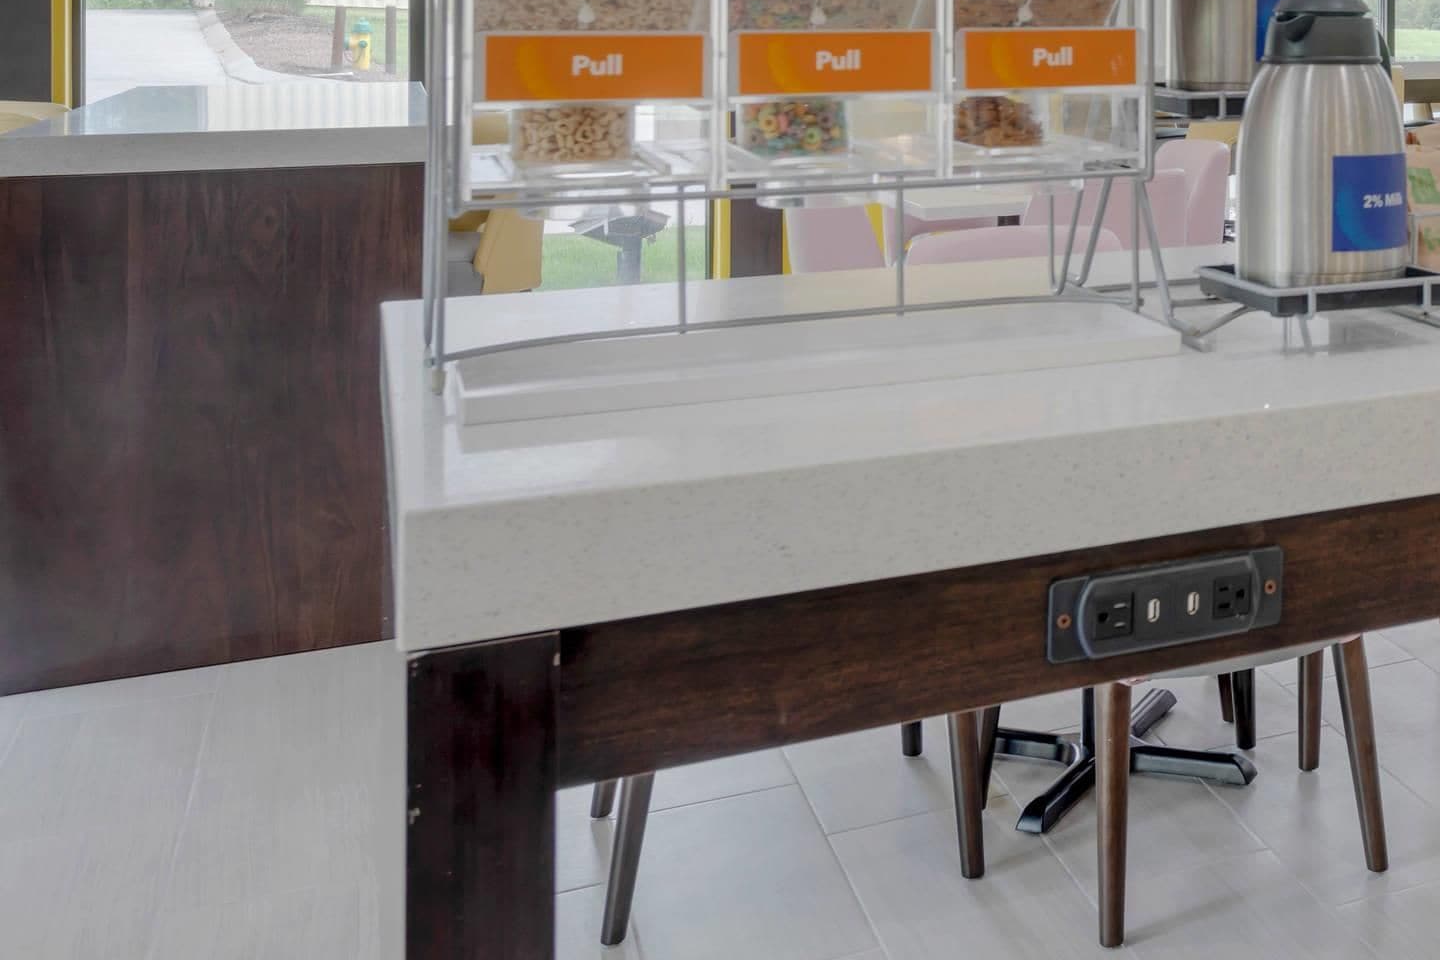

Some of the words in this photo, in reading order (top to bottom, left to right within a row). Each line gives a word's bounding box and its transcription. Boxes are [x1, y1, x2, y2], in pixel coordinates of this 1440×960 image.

[572, 53, 623, 77] Pull
[815, 49, 861, 71] Pull
[1032, 46, 1073, 67] Pull
[1363, 194, 1384, 209] 2%
